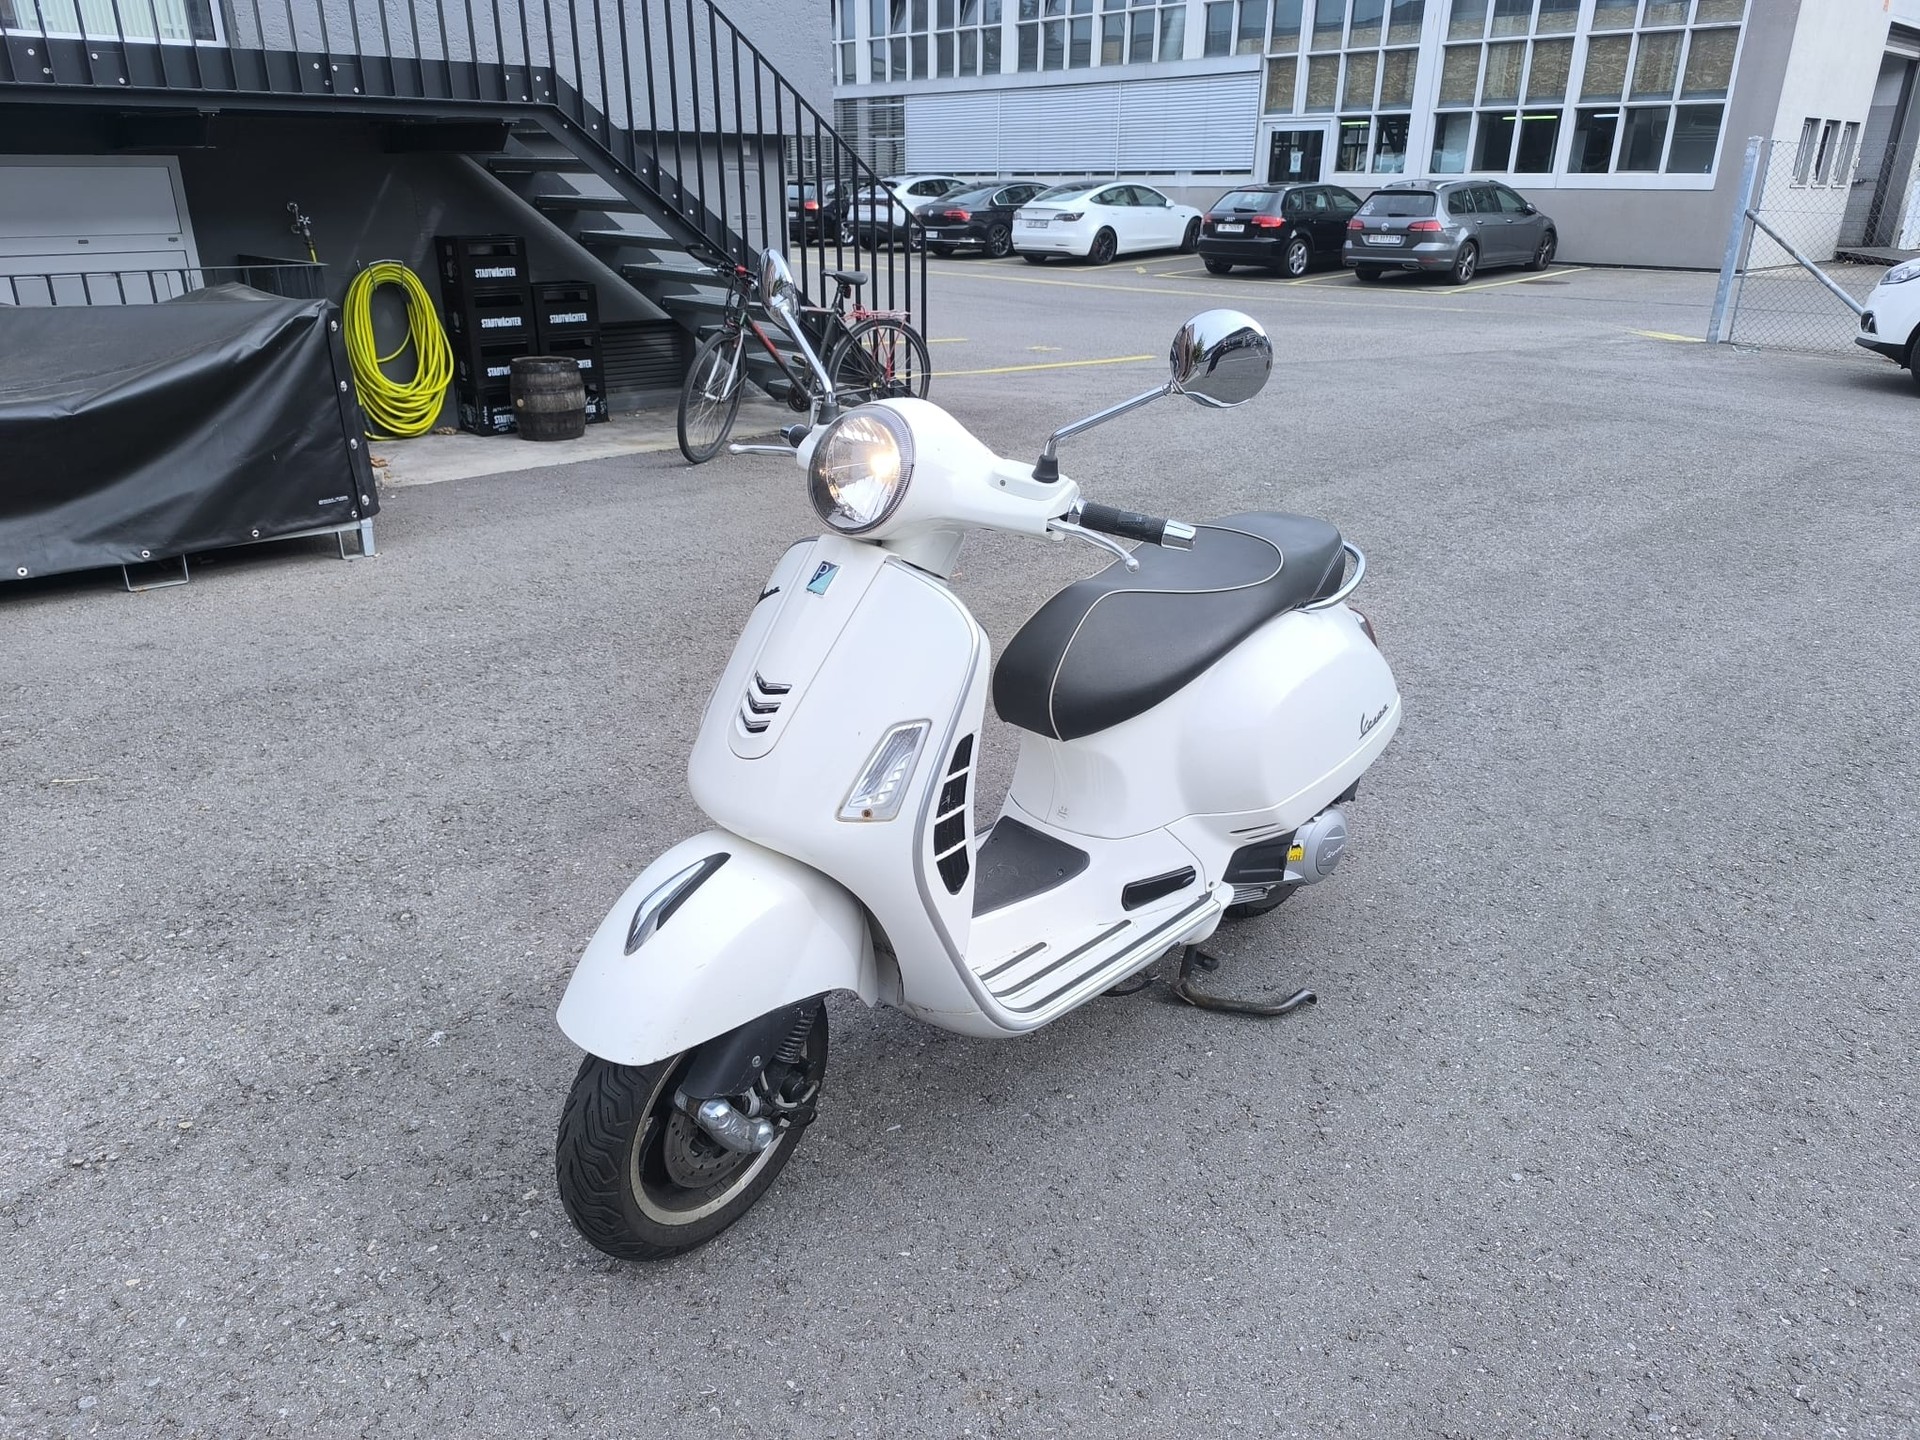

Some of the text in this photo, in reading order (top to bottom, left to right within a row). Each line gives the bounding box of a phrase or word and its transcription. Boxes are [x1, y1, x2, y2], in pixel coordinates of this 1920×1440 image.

[475, 266, 517, 279] STADTWÄCHTER
[481, 316, 522, 328] STADTWÄCHTER
[549, 312, 588, 324] STADTWÄCHTER
[812, 563, 830, 581] P
[1358, 703, 1389, 740] Vespa
